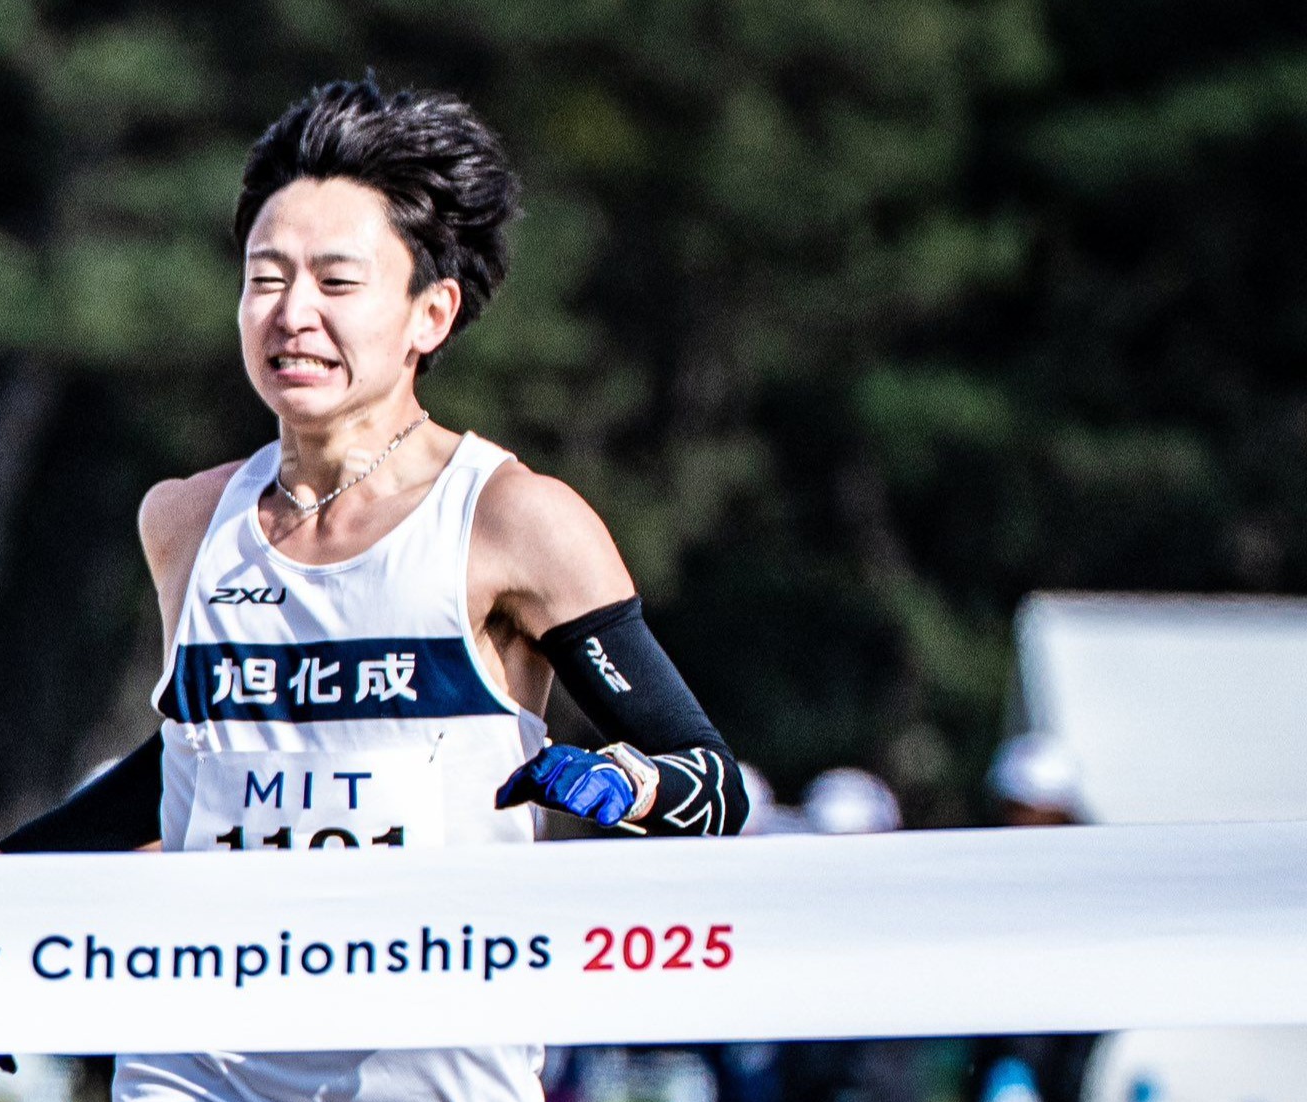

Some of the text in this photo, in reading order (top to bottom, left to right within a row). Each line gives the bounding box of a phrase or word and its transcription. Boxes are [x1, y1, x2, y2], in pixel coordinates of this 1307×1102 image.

[208, 587, 287, 605] 2XU
[212, 653, 418, 705] 旭化成
[244, 770, 372, 810] MIT
[31, 924, 552, 988] Championships
[582, 924, 734, 972] 2025
